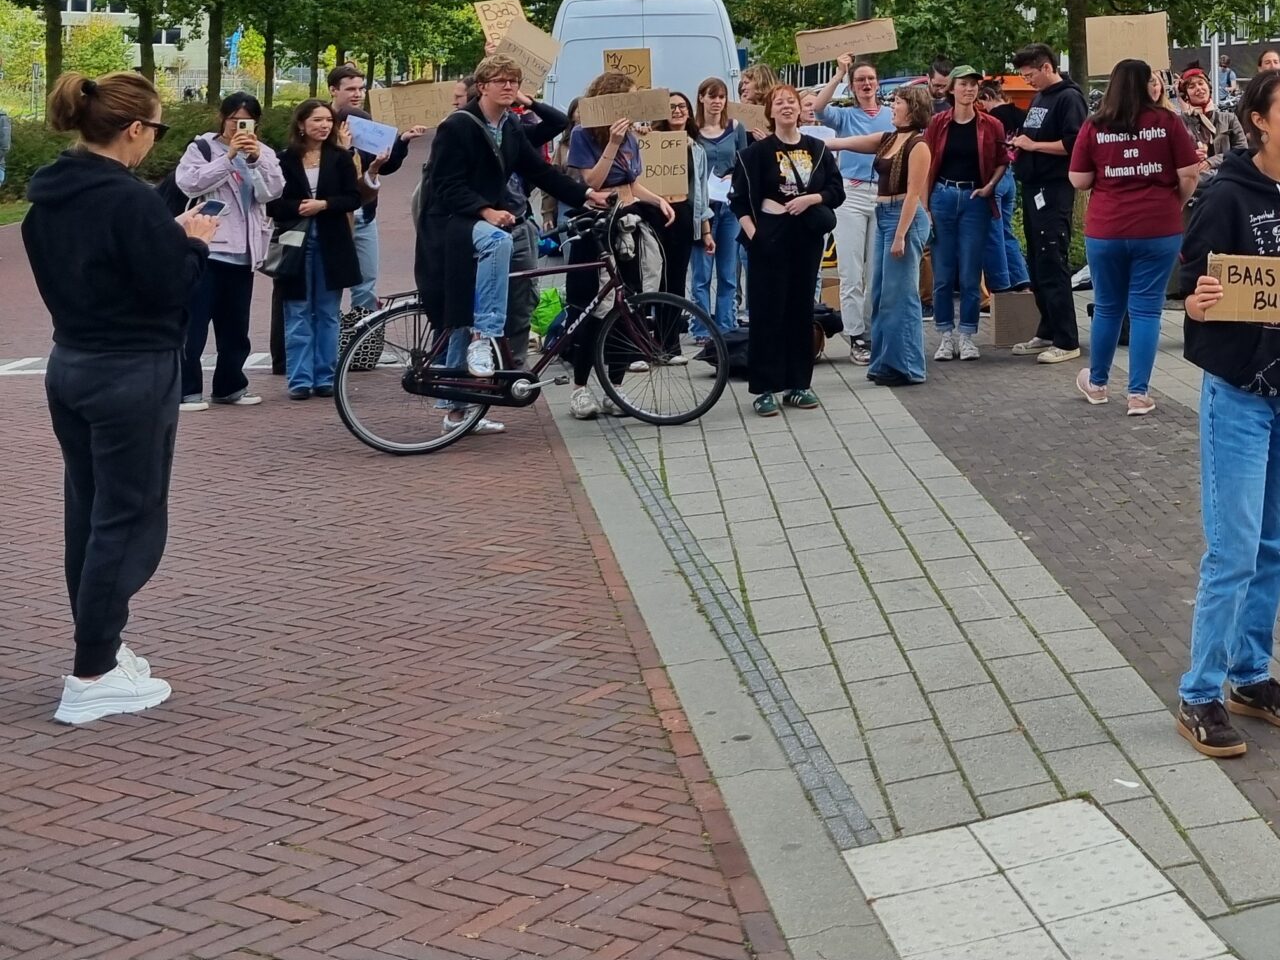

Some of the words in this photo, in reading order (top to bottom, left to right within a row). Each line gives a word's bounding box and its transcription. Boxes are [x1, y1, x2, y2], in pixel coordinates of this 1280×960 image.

[1096, 132, 1138, 144] Womens
[1139, 126, 1167, 141] rights
[638, 139, 651, 149] DS
[661, 139, 682, 149] OFF
[1123, 148, 1139, 159] are
[645, 164, 686, 179] BODIES
[1104, 165, 1136, 178] Human
[1136, 161, 1163, 177] rights
[1227, 265, 1276, 287] BAAS
[566, 294, 599, 335] GIANT
